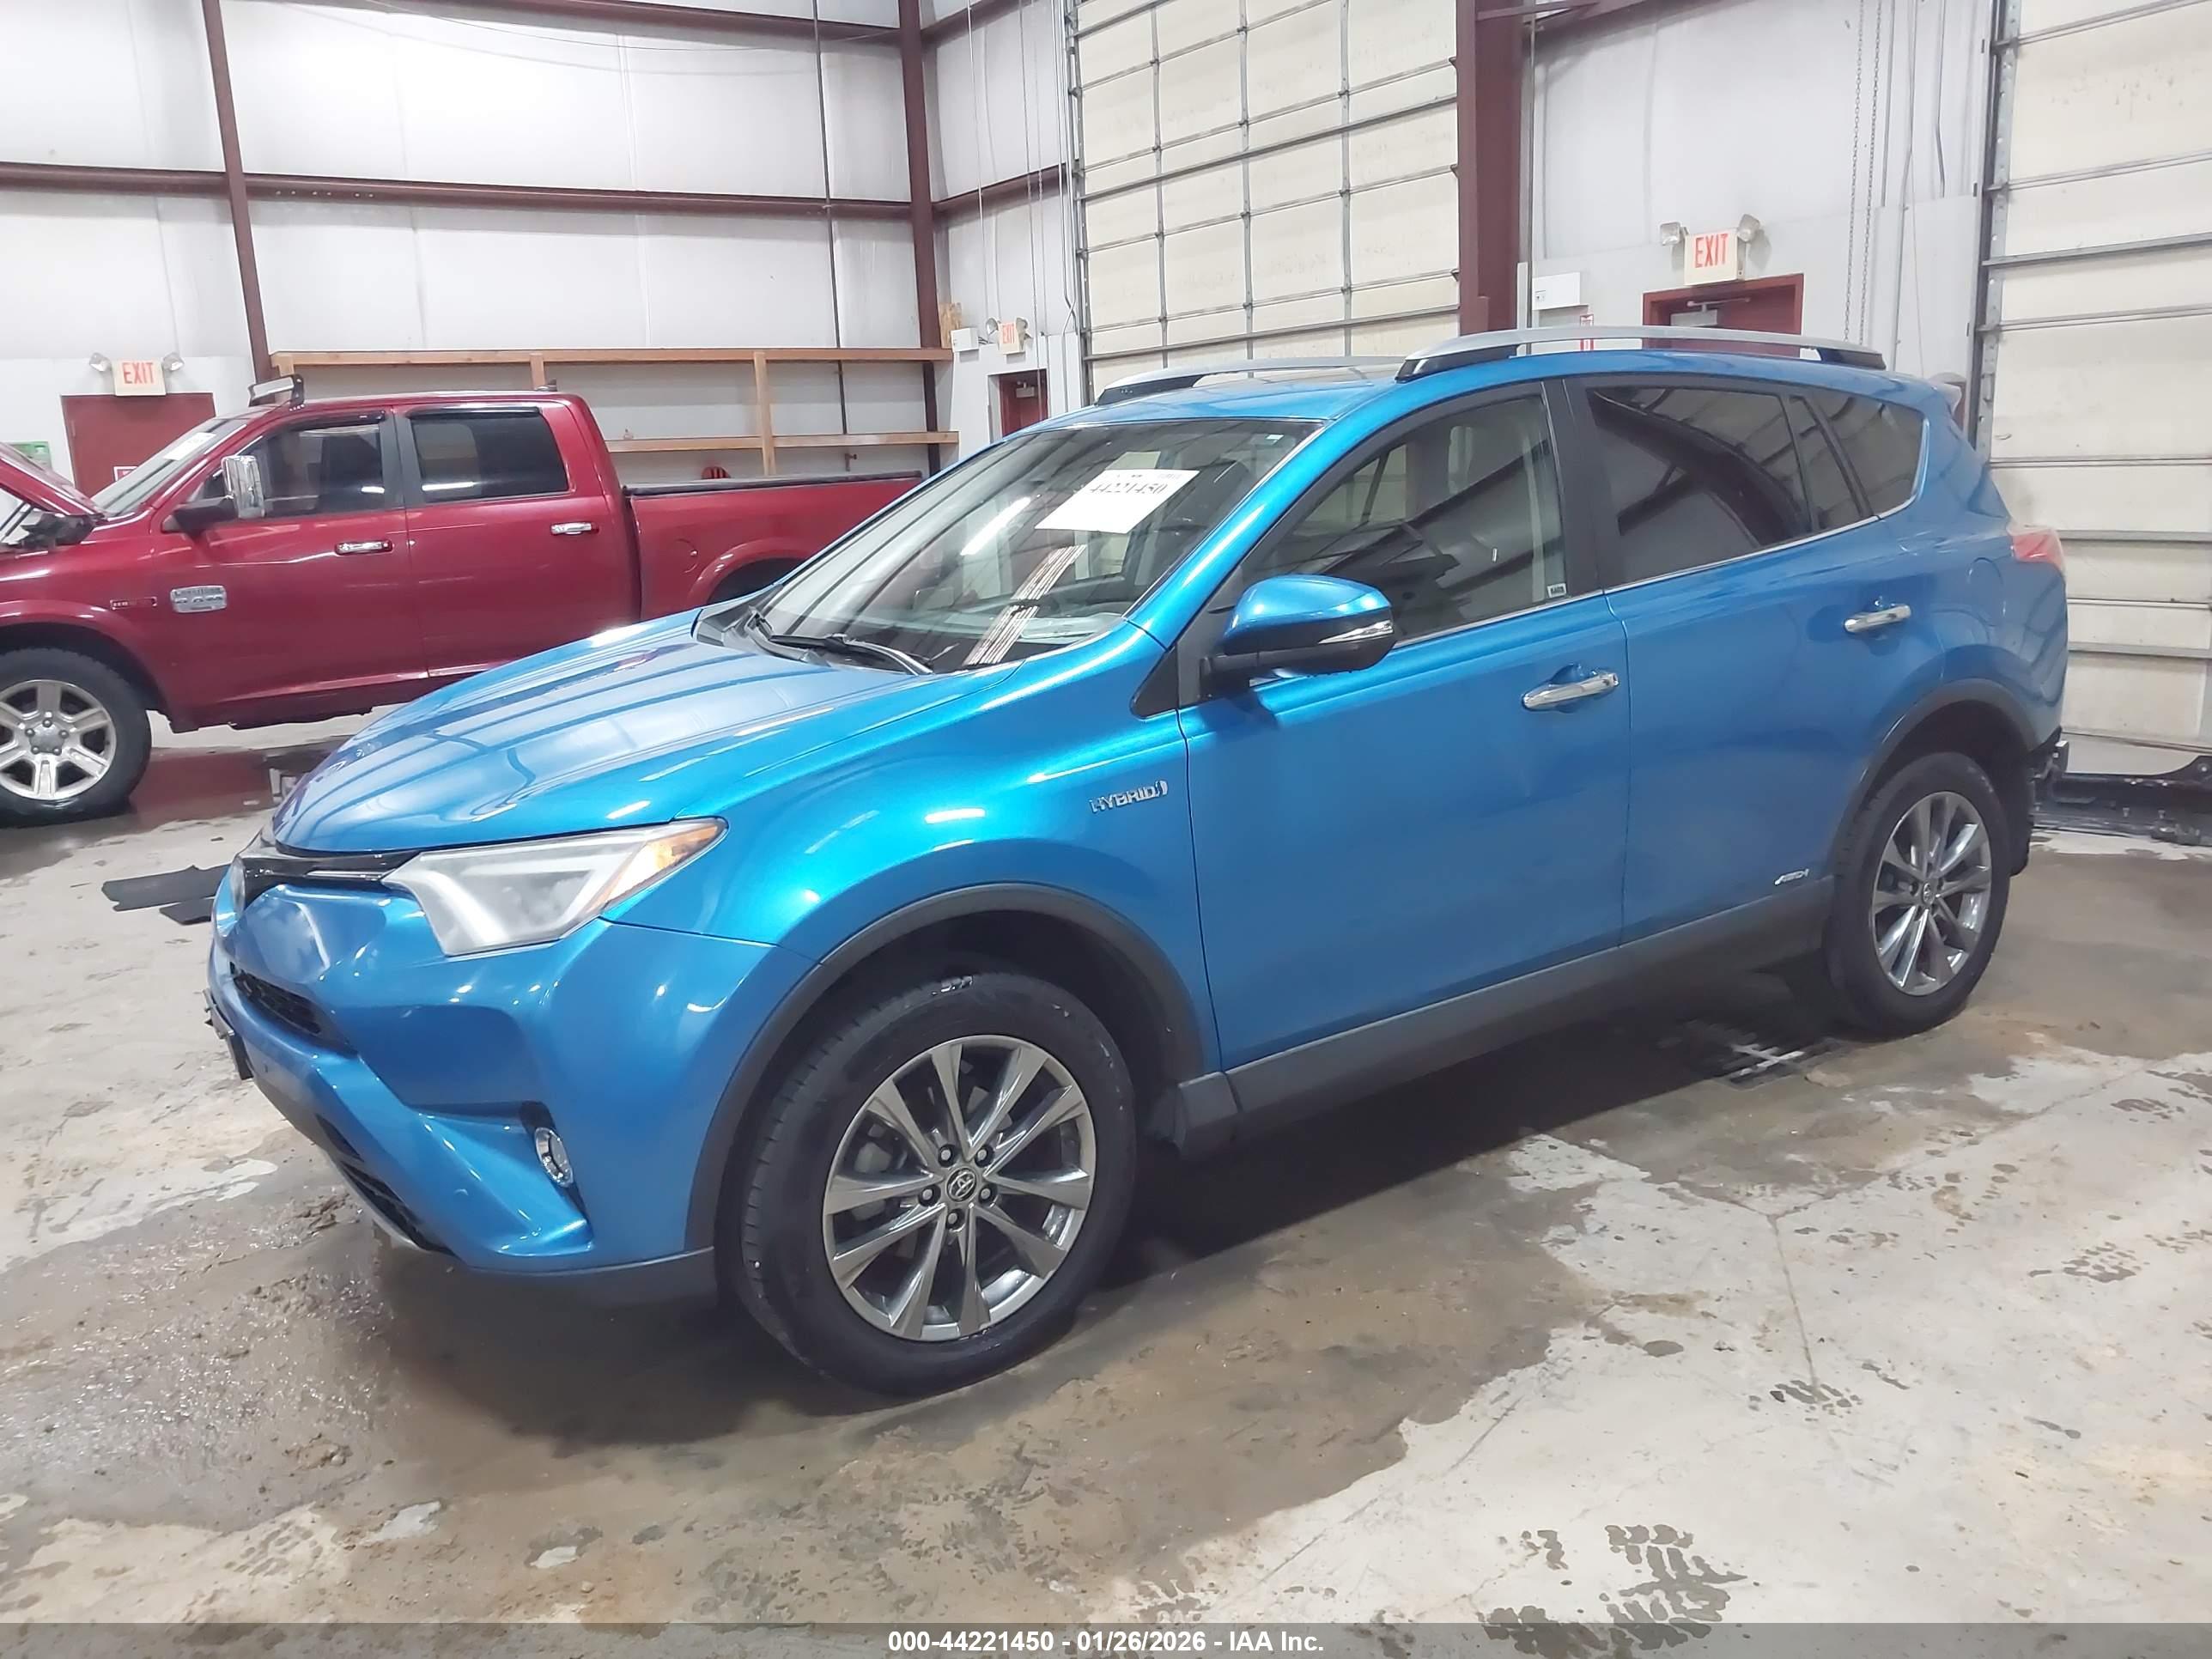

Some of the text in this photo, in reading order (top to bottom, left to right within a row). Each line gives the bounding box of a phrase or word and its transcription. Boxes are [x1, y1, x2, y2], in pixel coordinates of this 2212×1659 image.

[1694, 233, 1729, 269] EXIT
[1002, 323, 1015, 344] EXIT
[122, 362, 155, 385] EXIT
[1089, 786, 1157, 812] HYBRID
